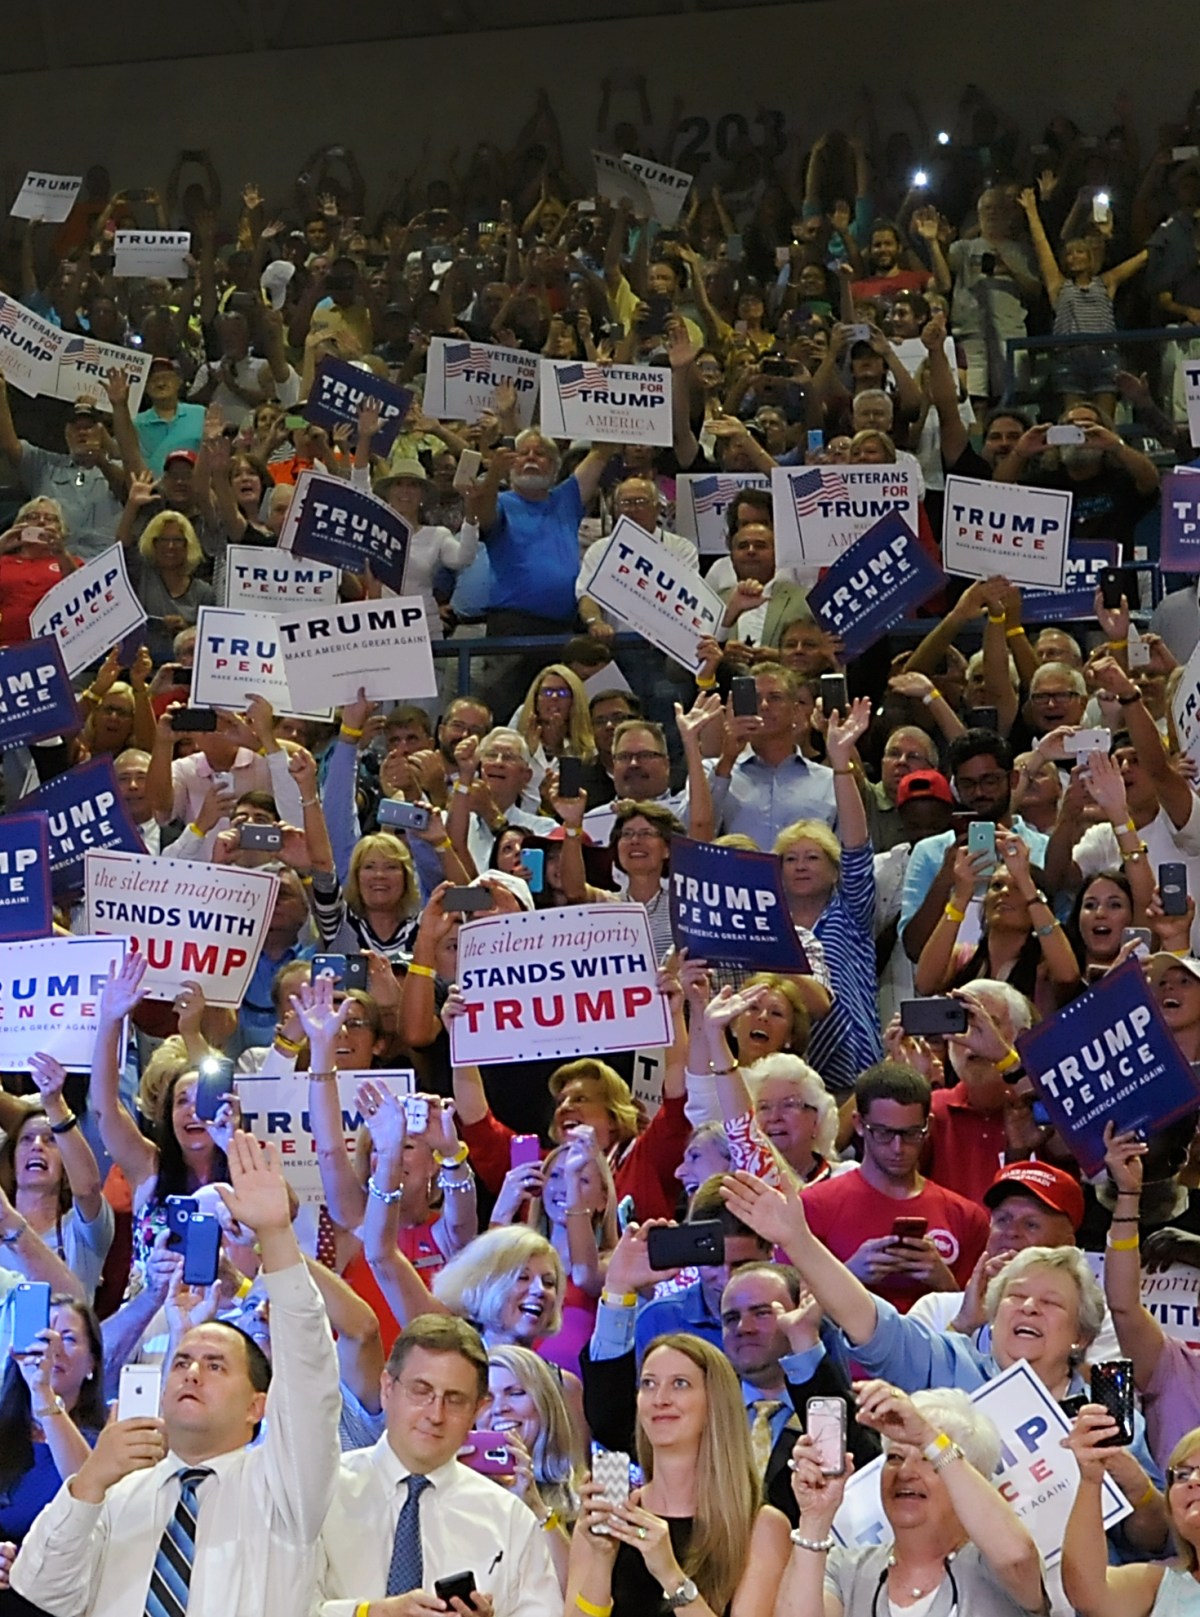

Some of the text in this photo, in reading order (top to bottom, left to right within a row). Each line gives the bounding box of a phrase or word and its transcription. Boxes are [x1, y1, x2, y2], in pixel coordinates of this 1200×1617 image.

[28, 176, 81, 192] TRUMP
[117, 234, 189, 245] TRUMP
[15, 309, 64, 345] VETERANS
[38, 336, 59, 353] FOR
[97, 346, 145, 366] VETERANS
[75, 359, 141, 385] TRUP
[124, 363, 143, 374] FOR
[487, 350, 537, 368] VETERANS
[517, 368, 535, 378] FOR
[601, 369, 664, 383] VETERANS
[578, 390, 665, 408] TRUMP
[640, 383, 664, 393] FOR
[585, 415, 656, 431] AMERICA
[737, 479, 772, 489] VETER
[840, 472, 909, 485] VETERANS
[882, 486, 909, 497] FOR
[313, 502, 402, 551] TRUMP
[953, 505, 1059, 535] TRUMP
[316, 521, 393, 559] PENCE
[959, 528, 1046, 550] PENCE
[235, 565, 333, 583] TRUMP
[619, 542, 715, 622] TRUMP
[821, 535, 909, 619] TRUMP
[242, 582, 322, 595] PENCE
[618, 565, 703, 629] PENCE
[833, 558, 911, 626] PENCE
[38, 568, 118, 636] TRUMP
[60, 590, 115, 639] ENCE
[279, 607, 422, 643] TRUMP
[207, 637, 276, 658] TRU
[285, 635, 427, 661] MAKE AMERICA GREAT AGAIN!
[216, 659, 274, 674] PEN
[7, 711, 31, 722] GREAT
[48, 791, 115, 837] UMP
[0, 896, 30, 906] AGAIN!
[94, 868, 262, 911] the silent majority
[674, 872, 777, 912] TRUMP
[95, 900, 256, 938] STANDS WITH
[679, 903, 771, 931] PENCE
[464, 922, 641, 960] the silent majority
[721, 932, 747, 940] GREAT
[462, 953, 648, 990] STANDS WITH
[463, 986, 654, 1034] TRUMP
[29, 1023, 64, 1032] GREAT
[1040, 1005, 1152, 1098] TRUMP
[1062, 1043, 1155, 1117] PENCE
[1087, 1097, 1117, 1121] AMERICA
[1116, 1080, 1139, 1101] GREAT
[1139, 1063, 1166, 1085] AGAIN!
[1031, 1478, 1071, 1511] AGAIN!
